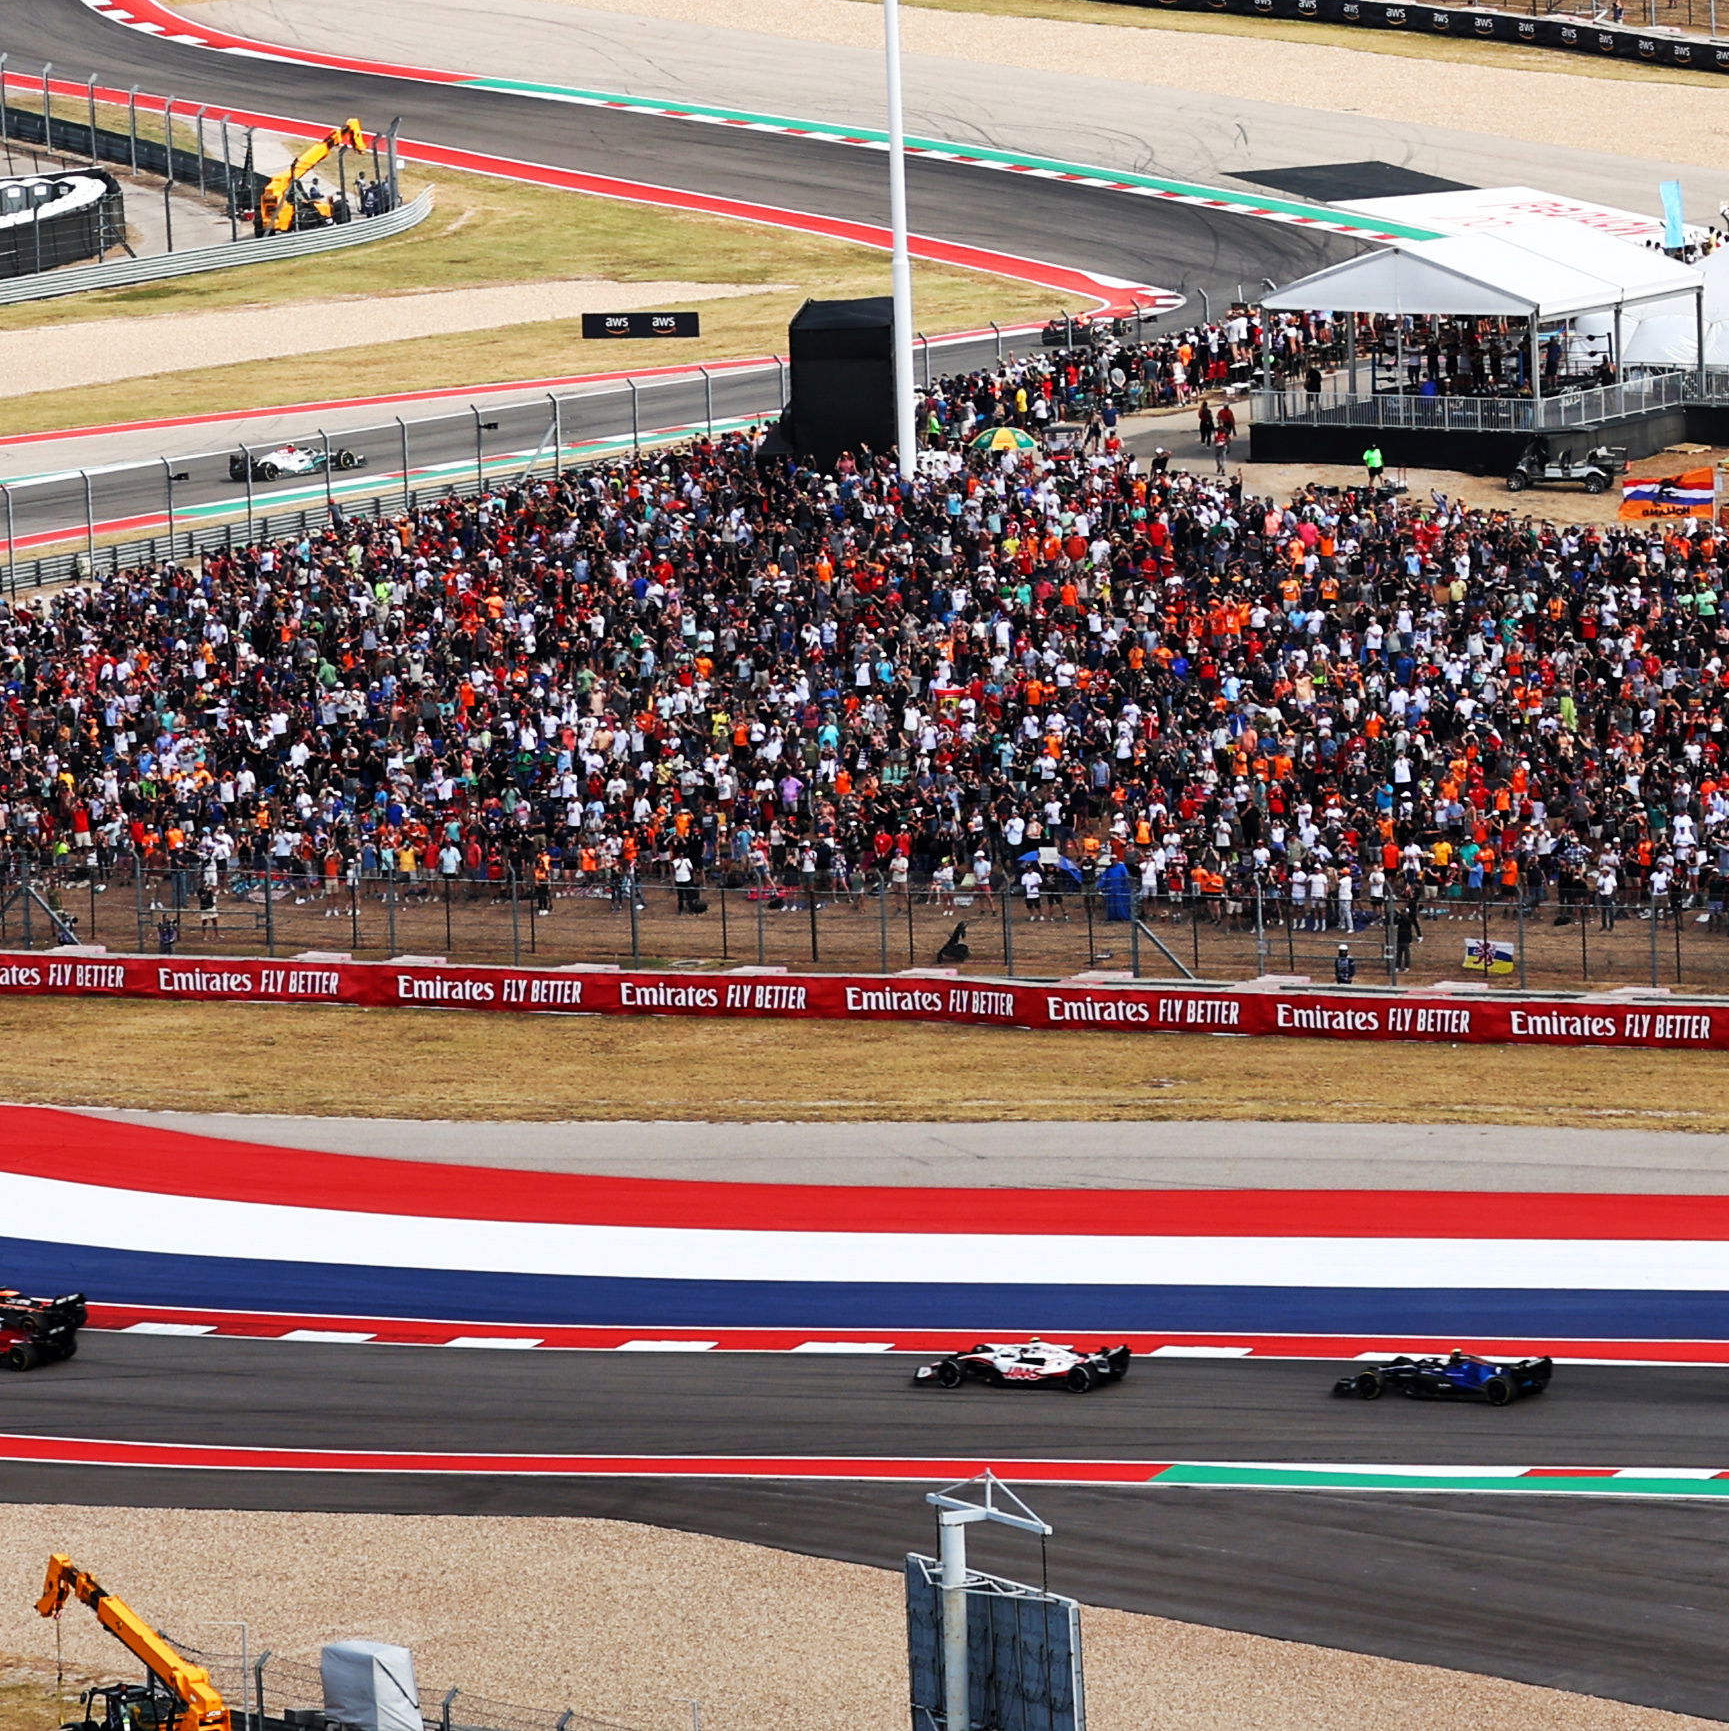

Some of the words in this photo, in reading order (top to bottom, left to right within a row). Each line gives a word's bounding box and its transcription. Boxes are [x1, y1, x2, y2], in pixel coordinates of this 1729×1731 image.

[605, 316, 628, 329] aws
[652, 316, 675, 329] aws
[49, 964, 72, 985] FLY
[77, 965, 123, 987] BETTER
[159, 968, 251, 991] Emirates
[261, 970, 285, 992] FLY
[289, 971, 338, 994] BETTER
[398, 976, 494, 1000] Emirates
[503, 980, 527, 1001] FLY
[531, 980, 581, 1003] BETTER
[621, 983, 717, 1006] Emirates
[727, 985, 751, 1007] FLY
[755, 986, 805, 1009] BETTER
[846, 987, 941, 1011] Emirates
[950, 990, 968, 1012] FLY
[972, 991, 1013, 1016] BETTER
[1048, 997, 1149, 1021] Emirates
[1160, 999, 1182, 1022] FLY
[1187, 1000, 1238, 1024] BETTER
[1277, 1004, 1378, 1030] Emirates
[1389, 1008, 1412, 1031] FLY
[1417, 1009, 1469, 1032] BETTER
[1511, 1011, 1615, 1036] Emirates
[1625, 1014, 1650, 1037] FLY
[1655, 1015, 1709, 1038] BETTER
[1008, 1365, 1041, 1380] HAAS
